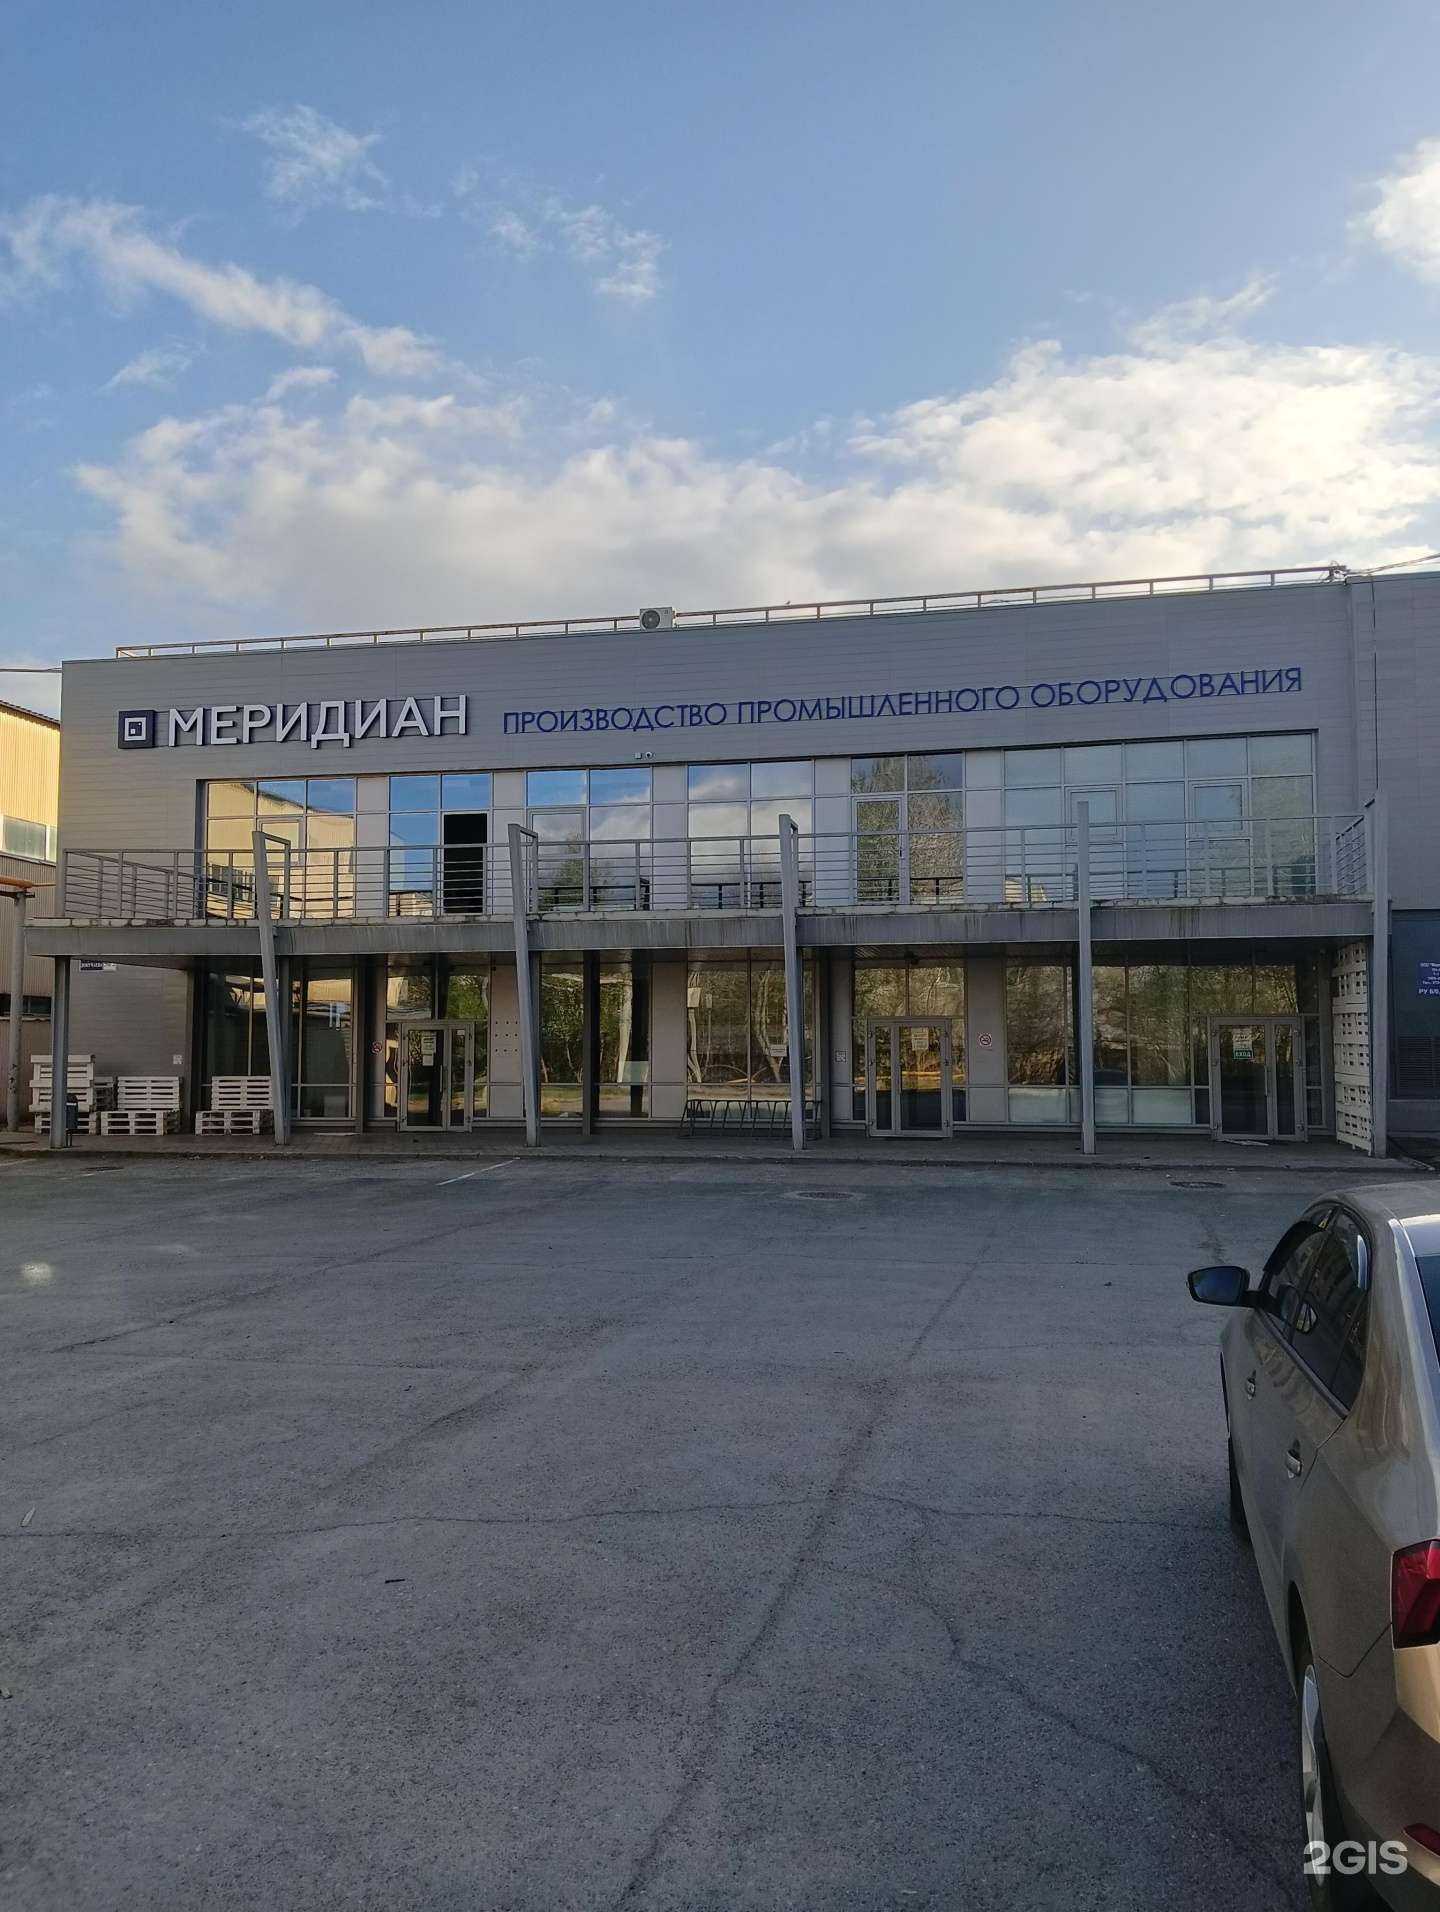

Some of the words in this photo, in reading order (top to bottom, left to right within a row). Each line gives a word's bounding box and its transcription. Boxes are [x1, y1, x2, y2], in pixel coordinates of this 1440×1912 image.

[168, 694, 467, 749] МЕРИДИАН
[503, 702, 727, 734] ПРОИЗВОДСТВО
[738, 686, 1019, 724] ПРОМЫШЛЕННОГО
[1031, 667, 1302, 708] ОБОРУДОВАНИЯ
